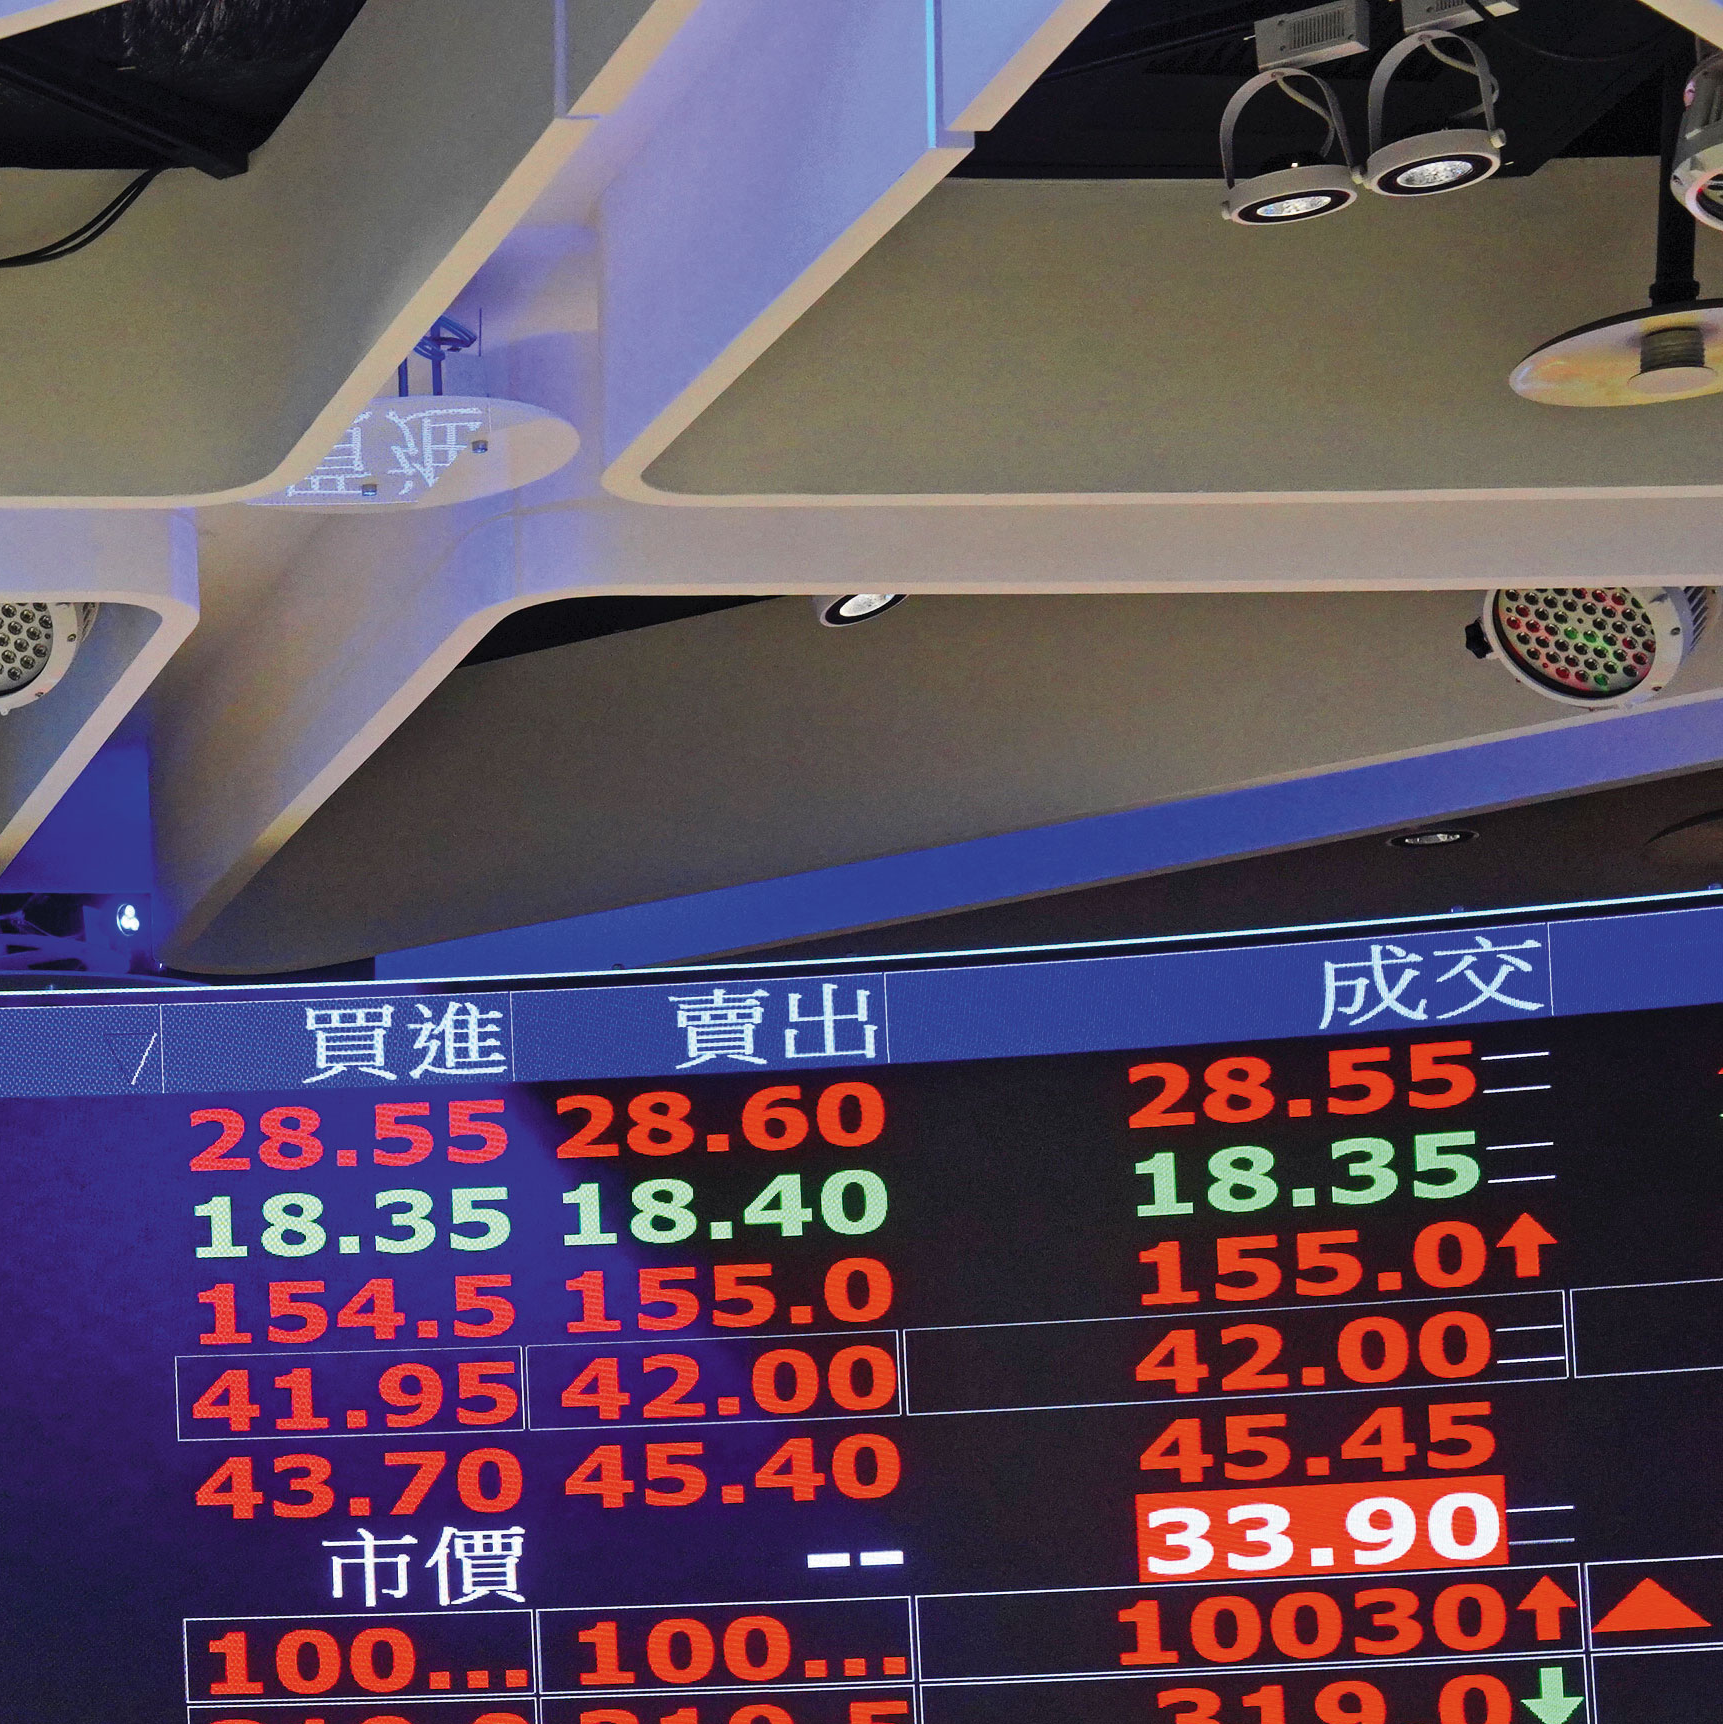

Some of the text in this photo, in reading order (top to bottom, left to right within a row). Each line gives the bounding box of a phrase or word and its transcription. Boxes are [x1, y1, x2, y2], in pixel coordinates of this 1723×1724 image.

[301, 1001, 510, 1085] 買進
[670, 982, 881, 1072] 賣出
[1316, 934, 1548, 1032] 成交
[189, 1039, 1477, 1172] 28.55 28.60 28.55
[194, 1130, 1481, 1259] 18.35 18.40 18.35
[192, 1310, 1492, 1432] 41.95 42.00 42.00
[321, 1492, 1500, 1608] 市價 33.90
[1117, 1583, 1508, 1666] 10030
